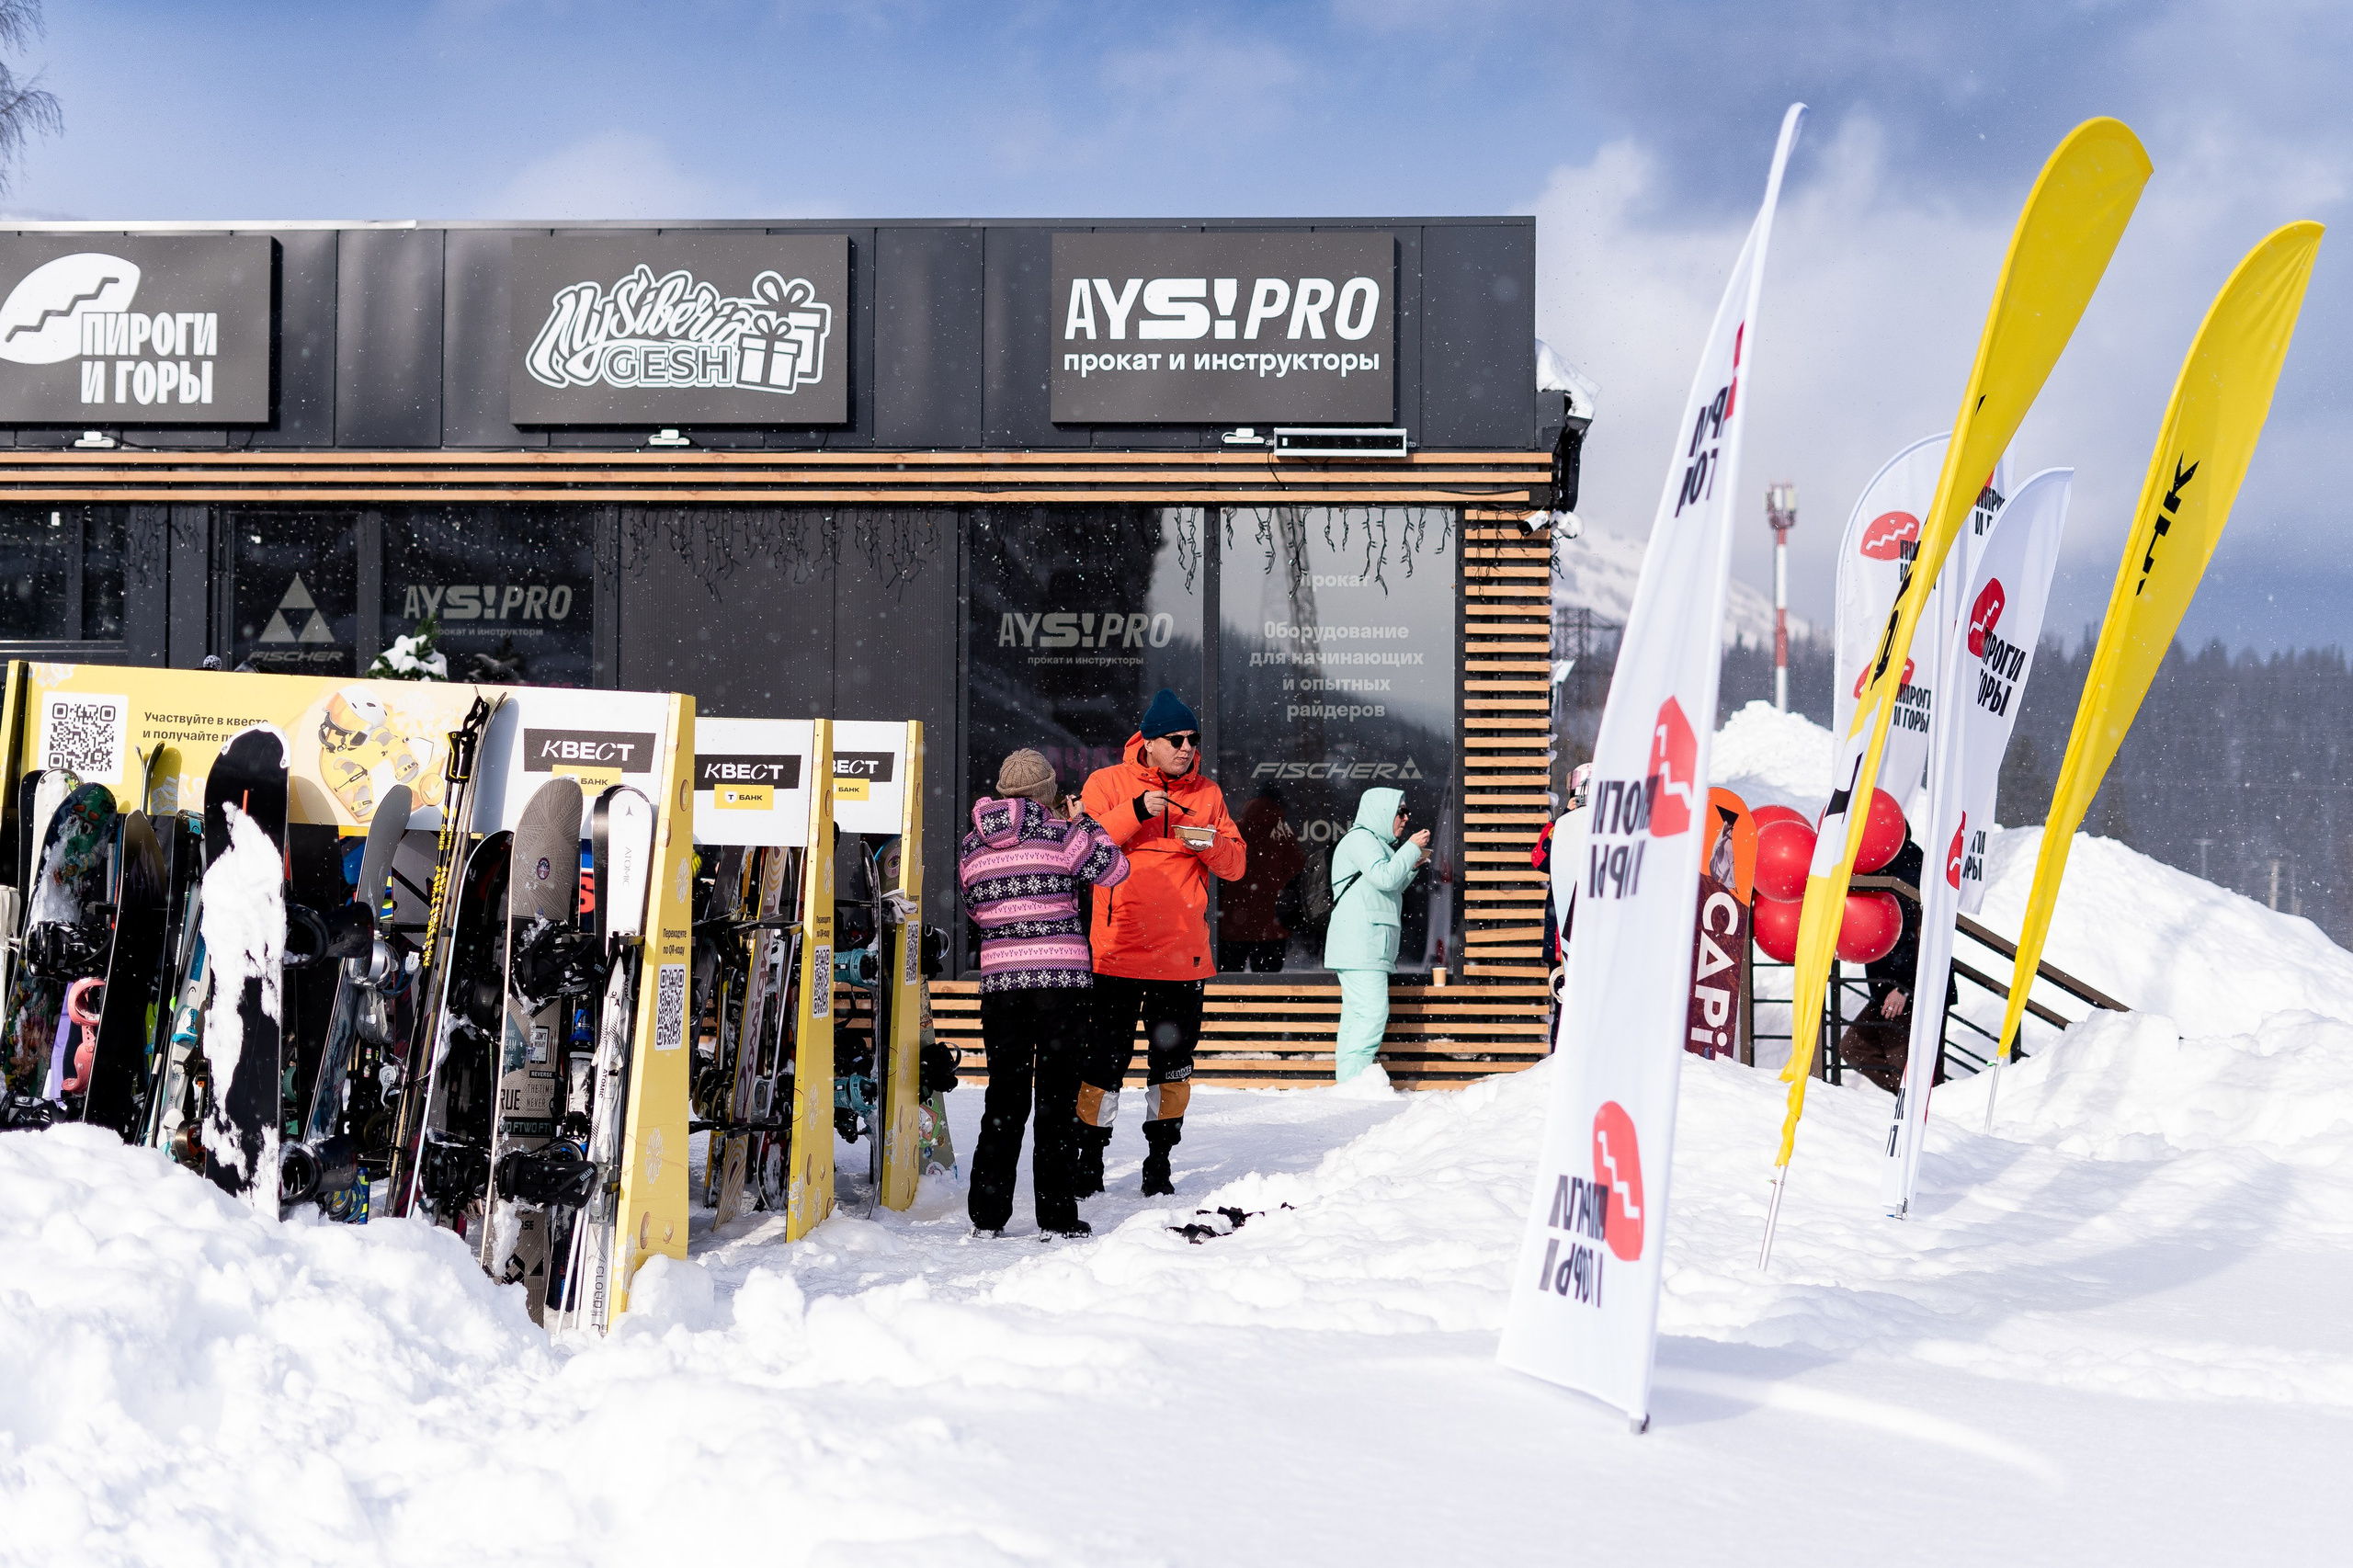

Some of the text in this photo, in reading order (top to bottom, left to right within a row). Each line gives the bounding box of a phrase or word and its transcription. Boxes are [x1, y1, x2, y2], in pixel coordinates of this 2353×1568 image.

[81, 312, 217, 356] ПИРОГИ
[607, 345, 733, 385] GESH
[1064, 353, 1380, 378] прокат и инструкторы
[81, 361, 213, 404] И ГОРЫ
[1264, 620, 1409, 643] Оборудование
[247, 651, 345, 662] FISCHER
[1028, 657, 1063, 666] прокат
[1075, 657, 1143, 666] инструкторы
[1249, 652, 1424, 667] для начинающих
[1282, 678, 1391, 691] и опытных
[144, 711, 214, 726] Участвуйте
[1287, 699, 1385, 722] райдеров
[1903, 708, 1930, 733] ГОРЫ
[142, 730, 150, 738] и
[153, 731, 219, 742] получайте
[541, 740, 634, 761] КВЕСТ
[704, 763, 784, 780] КВЕСТ
[1250, 762, 1398, 779] FISCHER
[580, 778, 608, 786] БАНК
[622, 846, 632, 888] ATOMIC
[663, 928, 687, 939] Переходите
[1165, 1065, 1192, 1080] KELME
[598, 1069, 608, 1098] ATOMIC
[579, 1167, 595, 1183] NITRO
